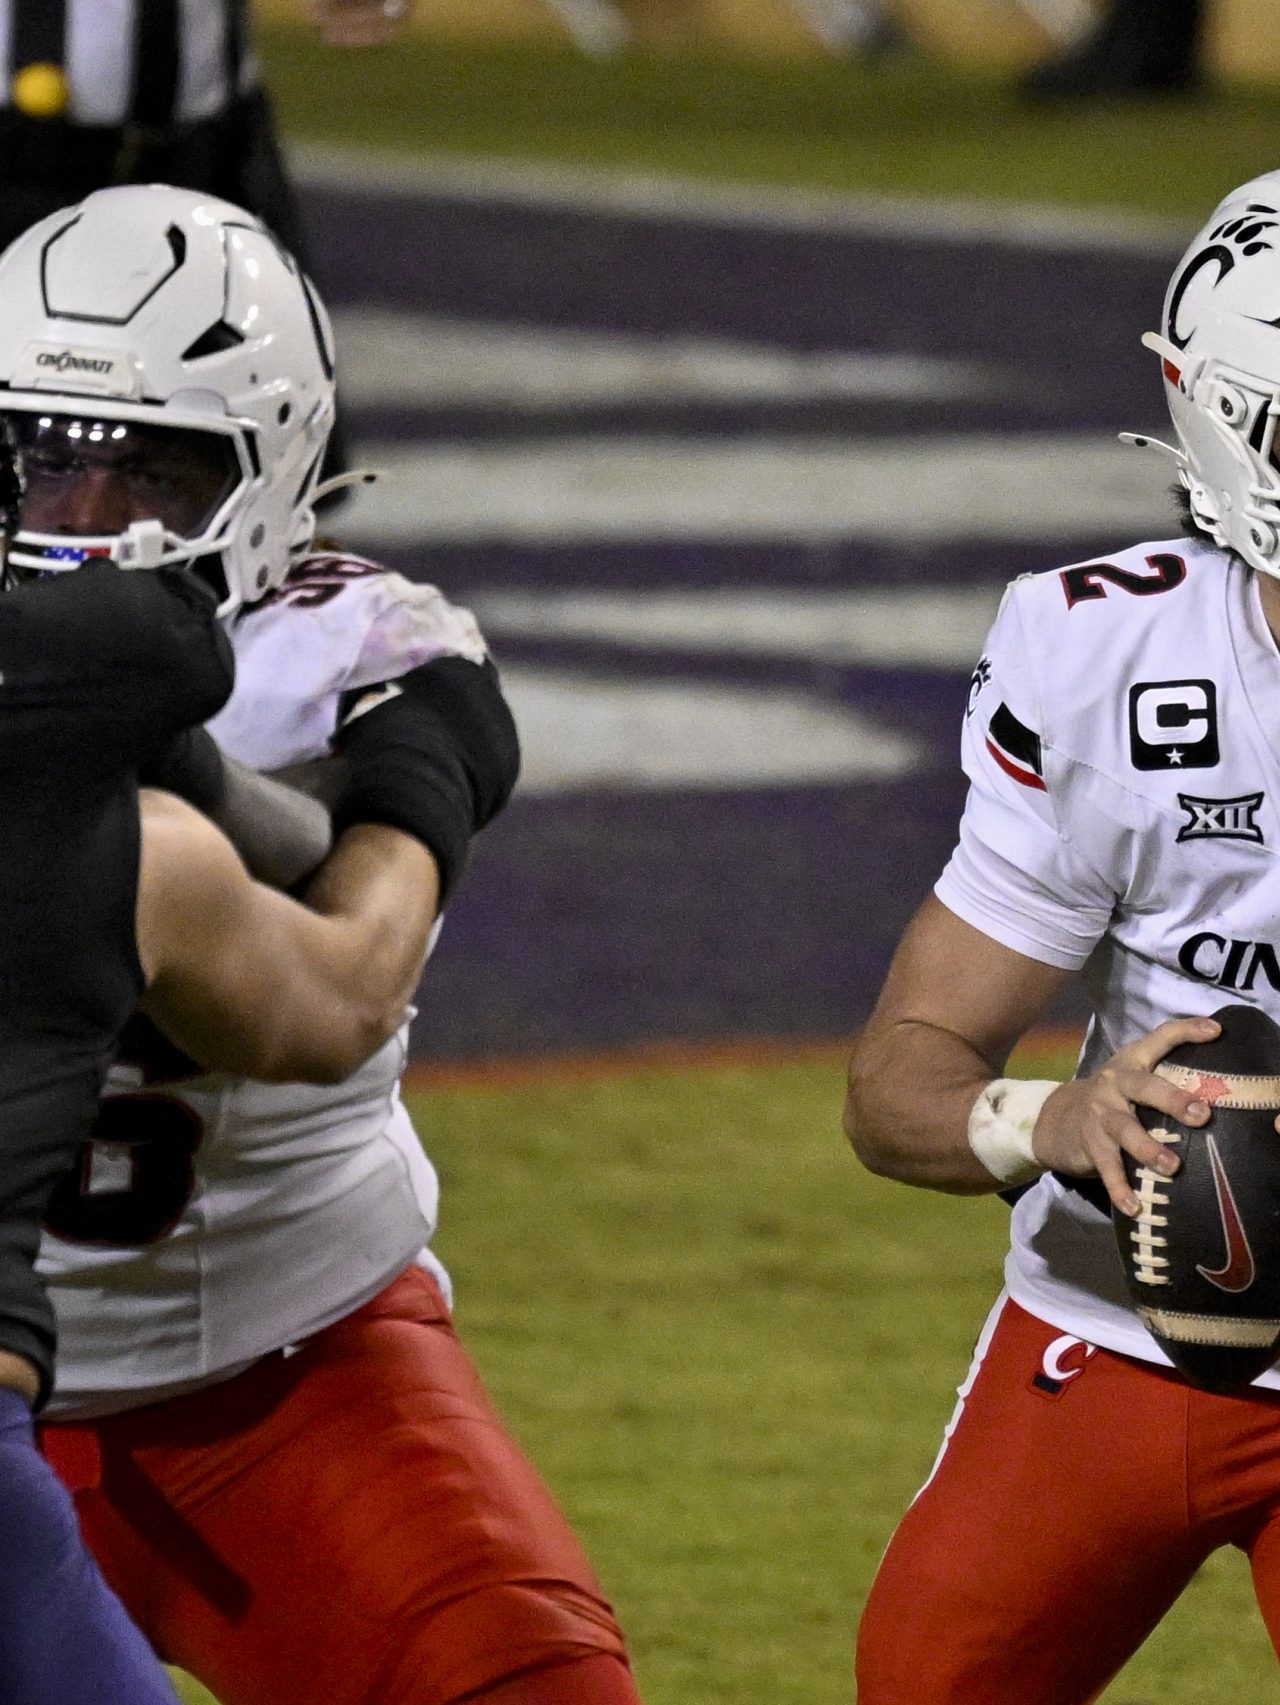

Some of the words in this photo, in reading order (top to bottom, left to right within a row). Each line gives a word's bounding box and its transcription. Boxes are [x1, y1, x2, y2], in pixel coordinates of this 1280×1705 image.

[1059, 553, 1188, 611] 2
[1136, 686, 1209, 746] C
[1188, 806, 1249, 832] XII
